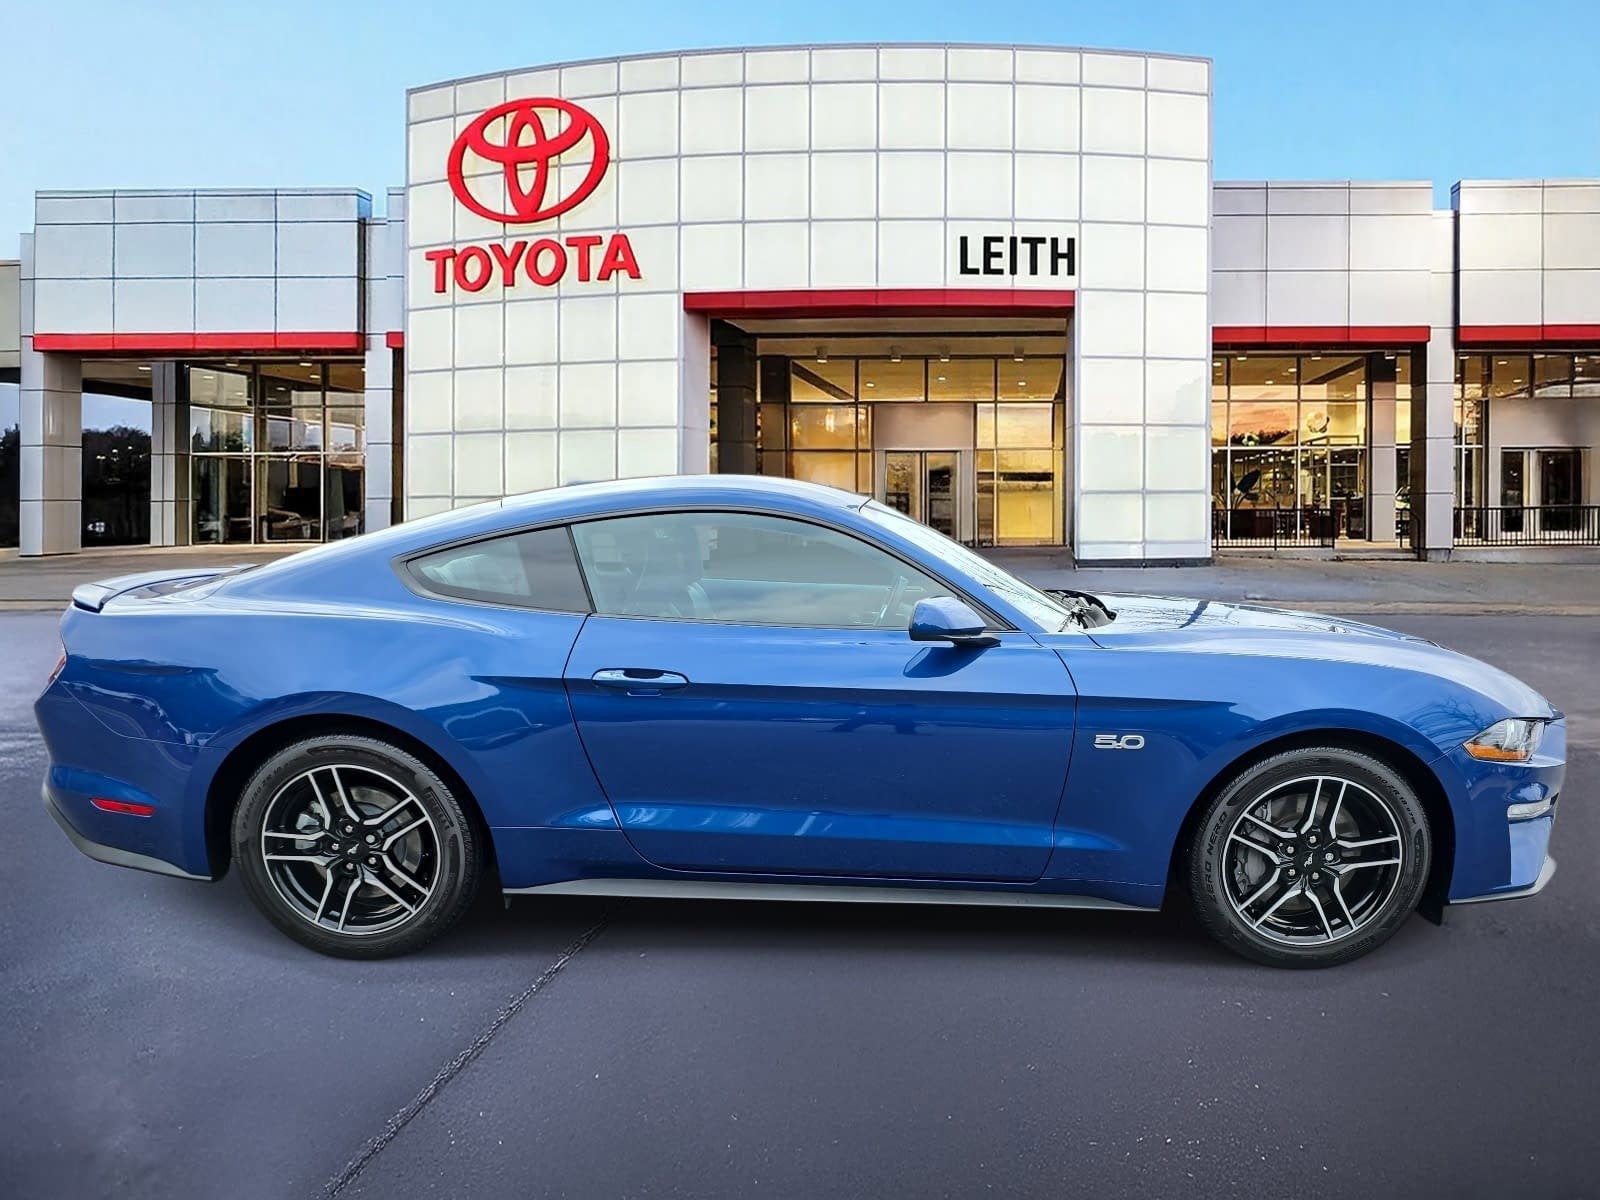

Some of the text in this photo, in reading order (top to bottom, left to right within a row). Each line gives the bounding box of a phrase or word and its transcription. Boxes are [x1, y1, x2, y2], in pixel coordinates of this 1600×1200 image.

[425, 233, 641, 293] TOYOTA
[960, 236, 1075, 276] LEITH
[1093, 734, 1145, 750] 5.0
